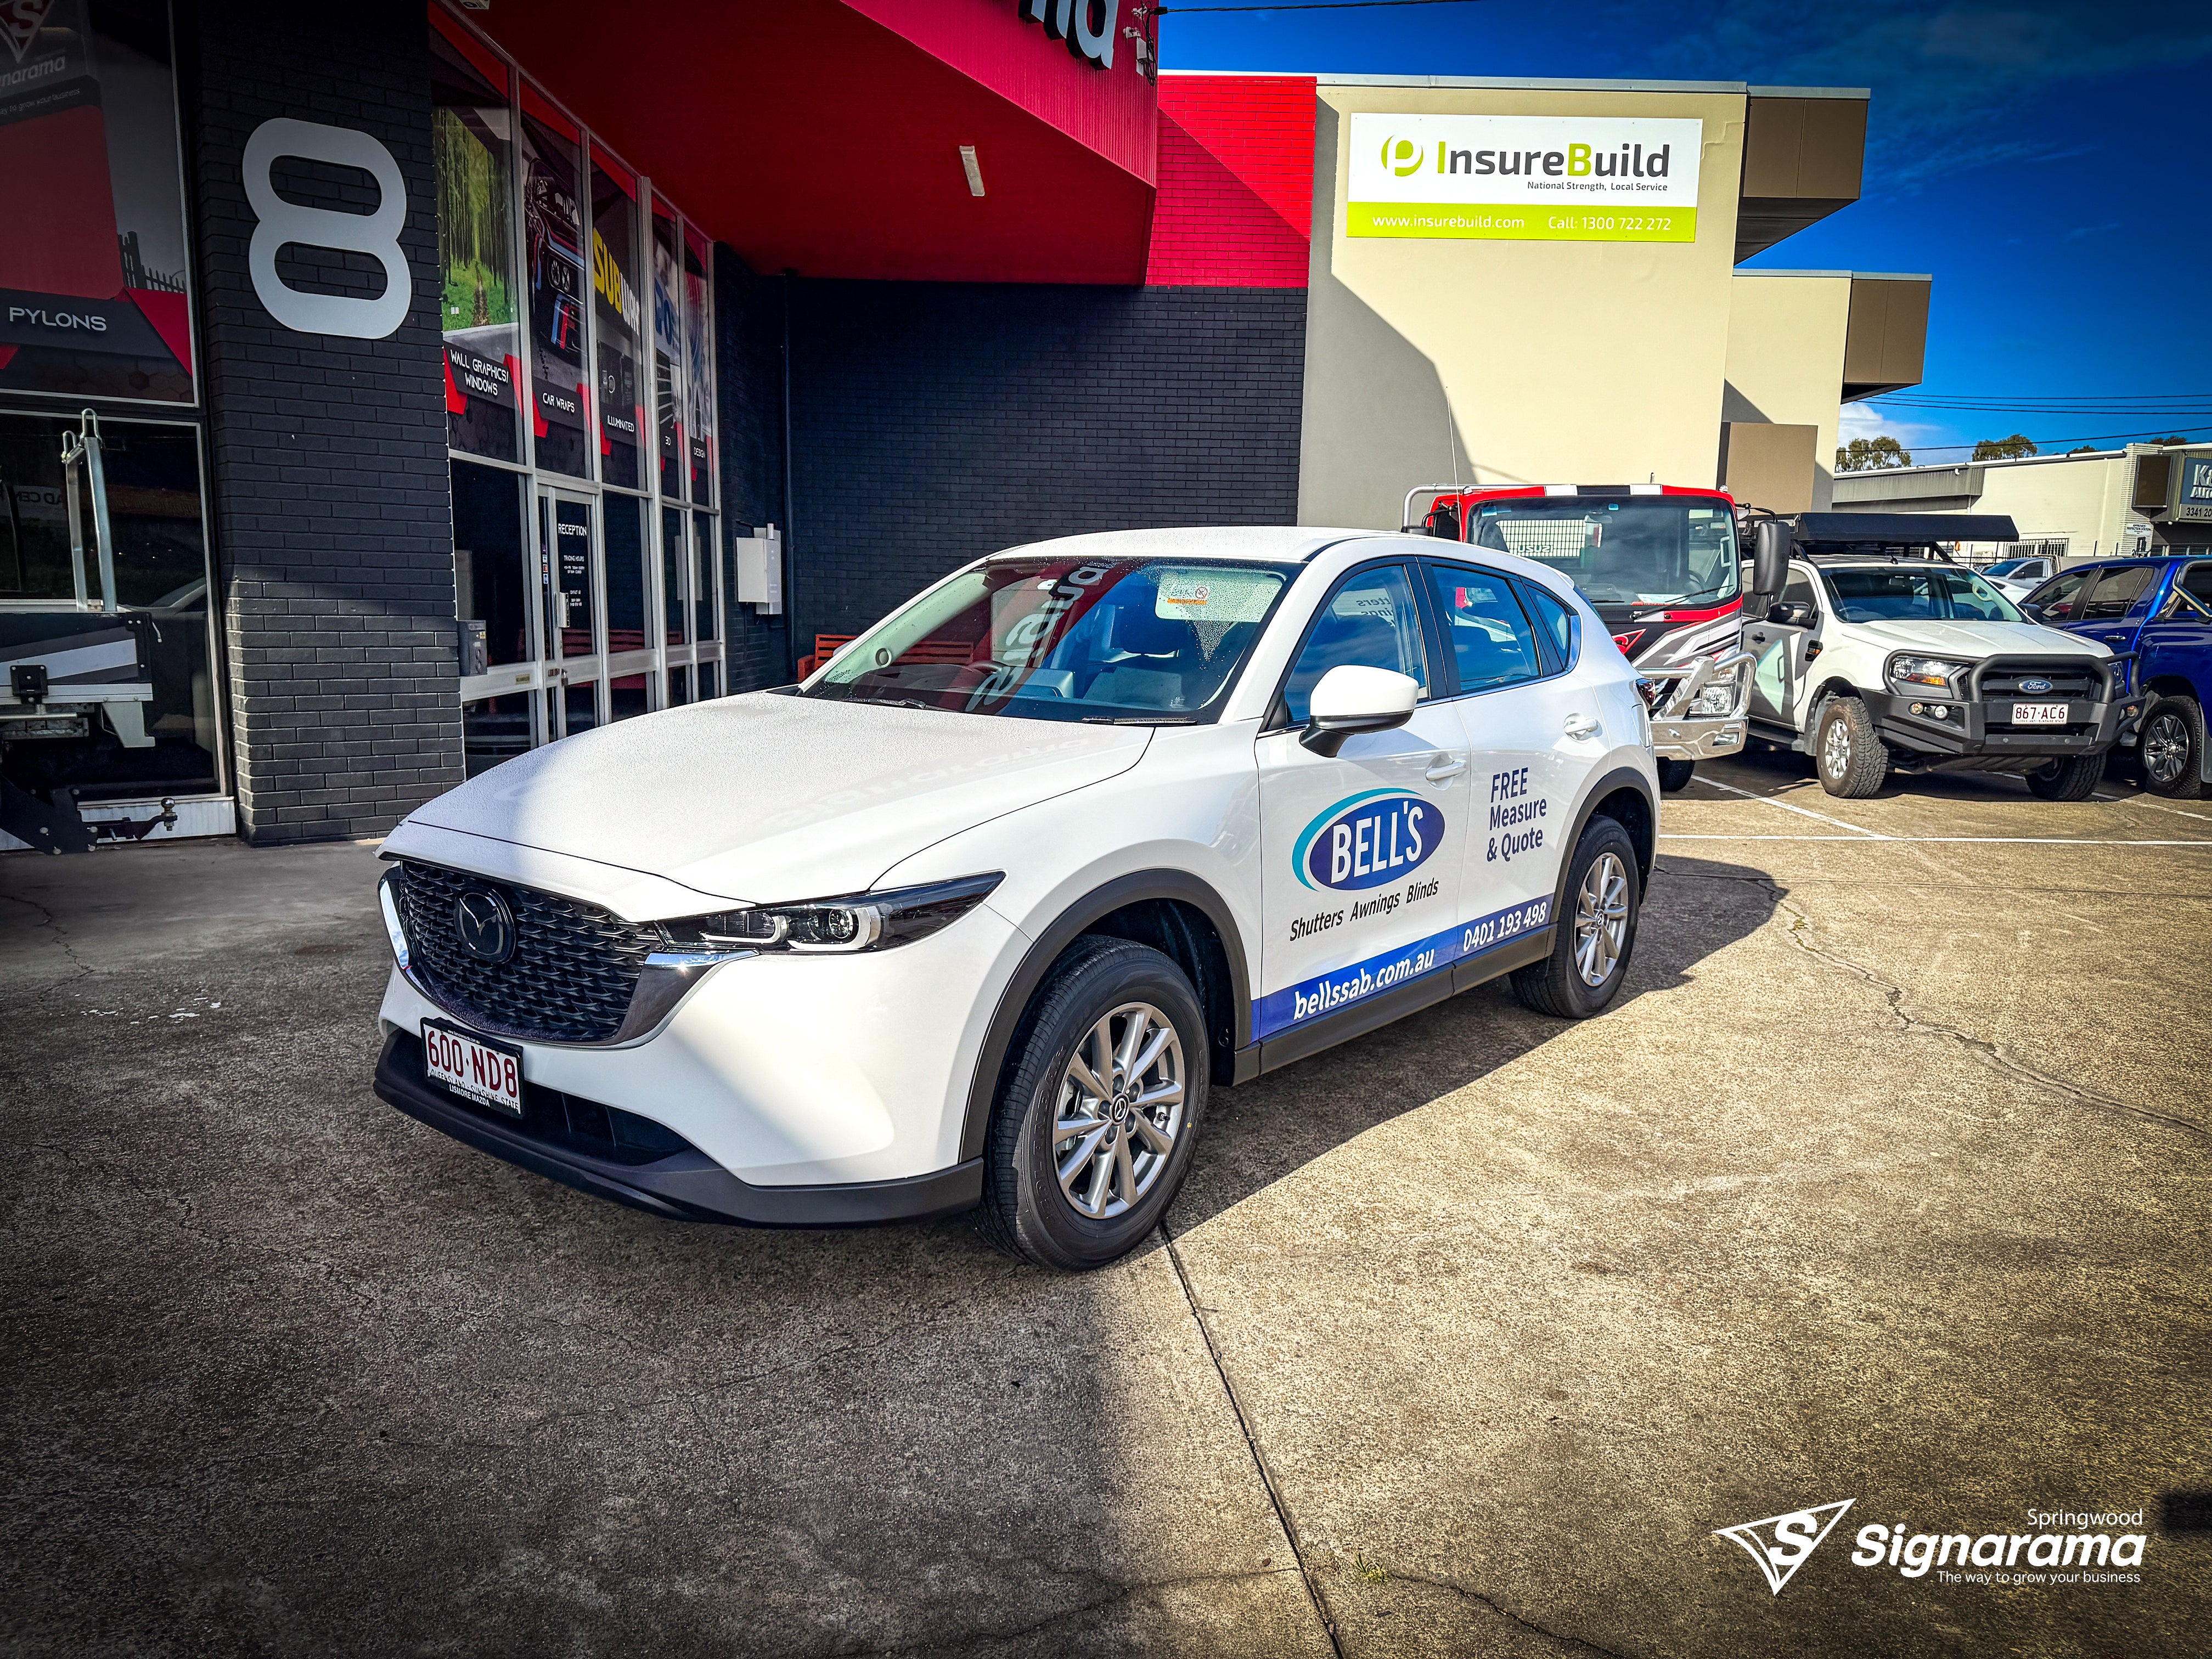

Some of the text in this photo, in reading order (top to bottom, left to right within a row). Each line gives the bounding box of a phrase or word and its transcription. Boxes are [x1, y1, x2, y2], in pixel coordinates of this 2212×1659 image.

[1437, 141, 1670, 177] InsureBuild
[1527, 182, 1564, 190] National
[1566, 182, 1607, 191] Strength,
[1636, 183, 1668, 191] Service
[242, 117, 412, 340] 8
[1372, 214, 1671, 230] www.insurebuild.com Call: 1300 722 272
[9, 307, 107, 331] PYLONS
[450, 349, 470, 369] WALL
[465, 373, 498, 396] WINDOWS
[542, 392, 575, 413] CAR WRAPS
[607, 415, 635, 433] ILLUMINATED
[665, 436, 671, 445] 3D
[2186, 507, 2202, 517] 3341
[558, 523, 587, 537] RECEPTION
[2027, 681, 2046, 690] Ford
[1490, 766, 1528, 803] FREE
[1489, 798, 1546, 831] Measure
[1331, 800, 1425, 884] BELL'S
[1486, 827, 1543, 862] & Quote
[1290, 877, 1439, 942] Shutters Awnings Blinds
[1462, 901, 1547, 952] 0401 193 498
[1293, 947, 1435, 1020] bellssab.com.au
[449, 1084, 490, 1107] LISMORE MAZDA
[501, 1097, 519, 1109] STATE
